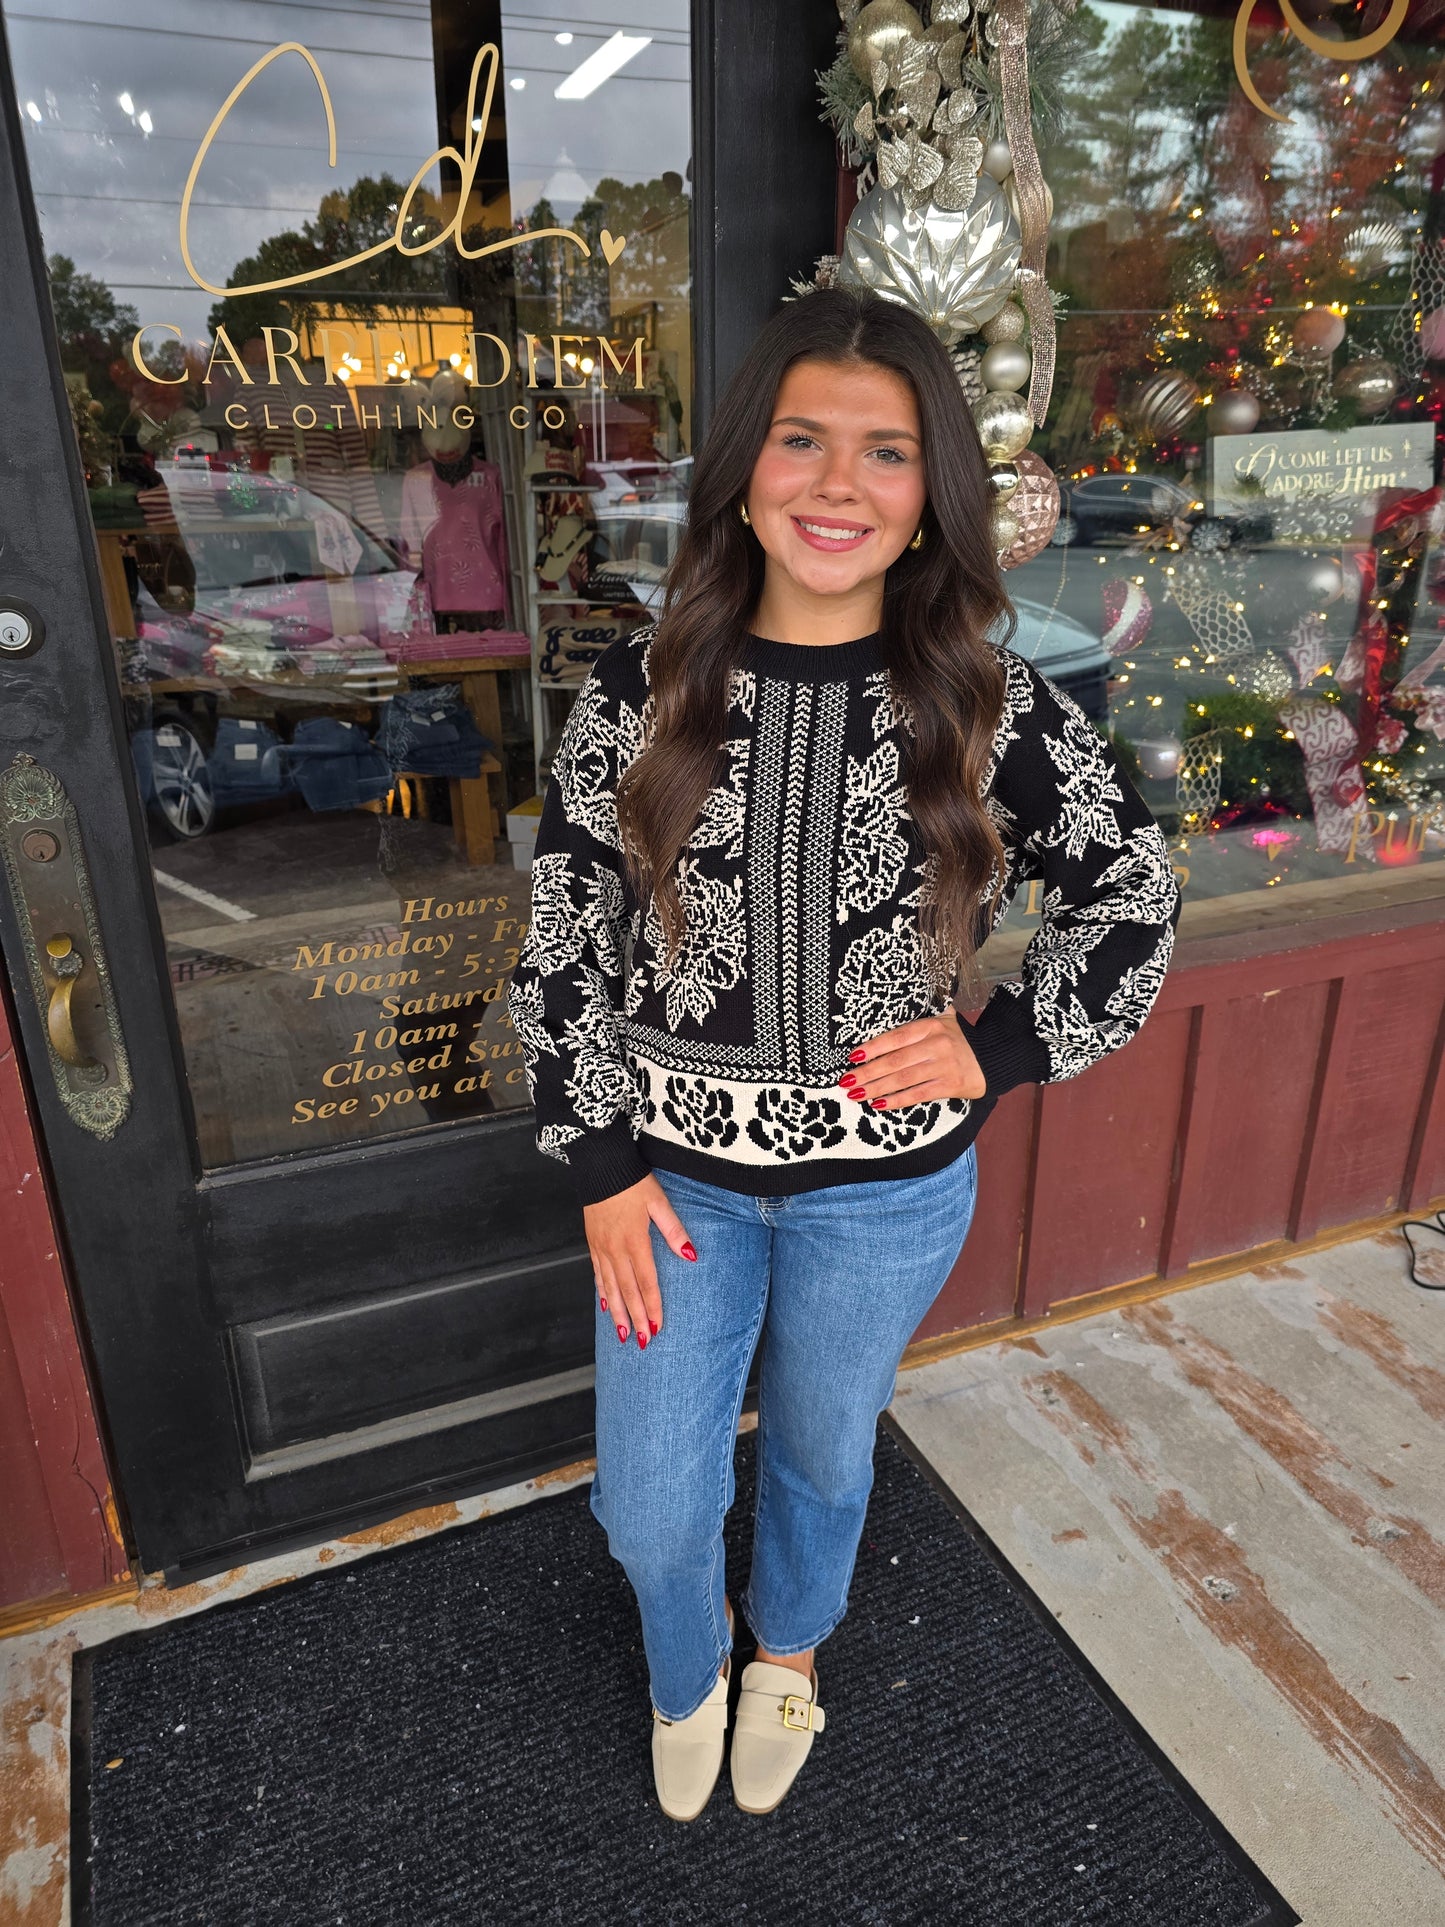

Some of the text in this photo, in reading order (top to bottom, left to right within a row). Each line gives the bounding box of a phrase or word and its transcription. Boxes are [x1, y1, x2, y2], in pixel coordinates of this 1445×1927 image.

[132, 324, 645, 389] CARPE DIEM
[225, 403, 585, 430] CLOTHING CO.
[1278, 449, 1331, 470] COME
[1336, 447, 1366, 466] LET
[1371, 446, 1393, 463] US
[1272, 465, 1397, 494] ADORE Him
[1344, 801, 1445, 864] Pur
[401, 895, 509, 924] Hours
[291, 931, 454, 972] Monday
[490, 917, 531, 943] Fr
[307, 967, 421, 1000] 10am
[459, 947, 520, 978] 5:3
[379, 978, 510, 1020] Saturd
[349, 1022, 459, 1055] 10am
[322, 1045, 452, 1088] Closed
[291, 1098, 359, 1124] See
[369, 1082, 442, 1118] you
[454, 1069, 494, 1094] at
